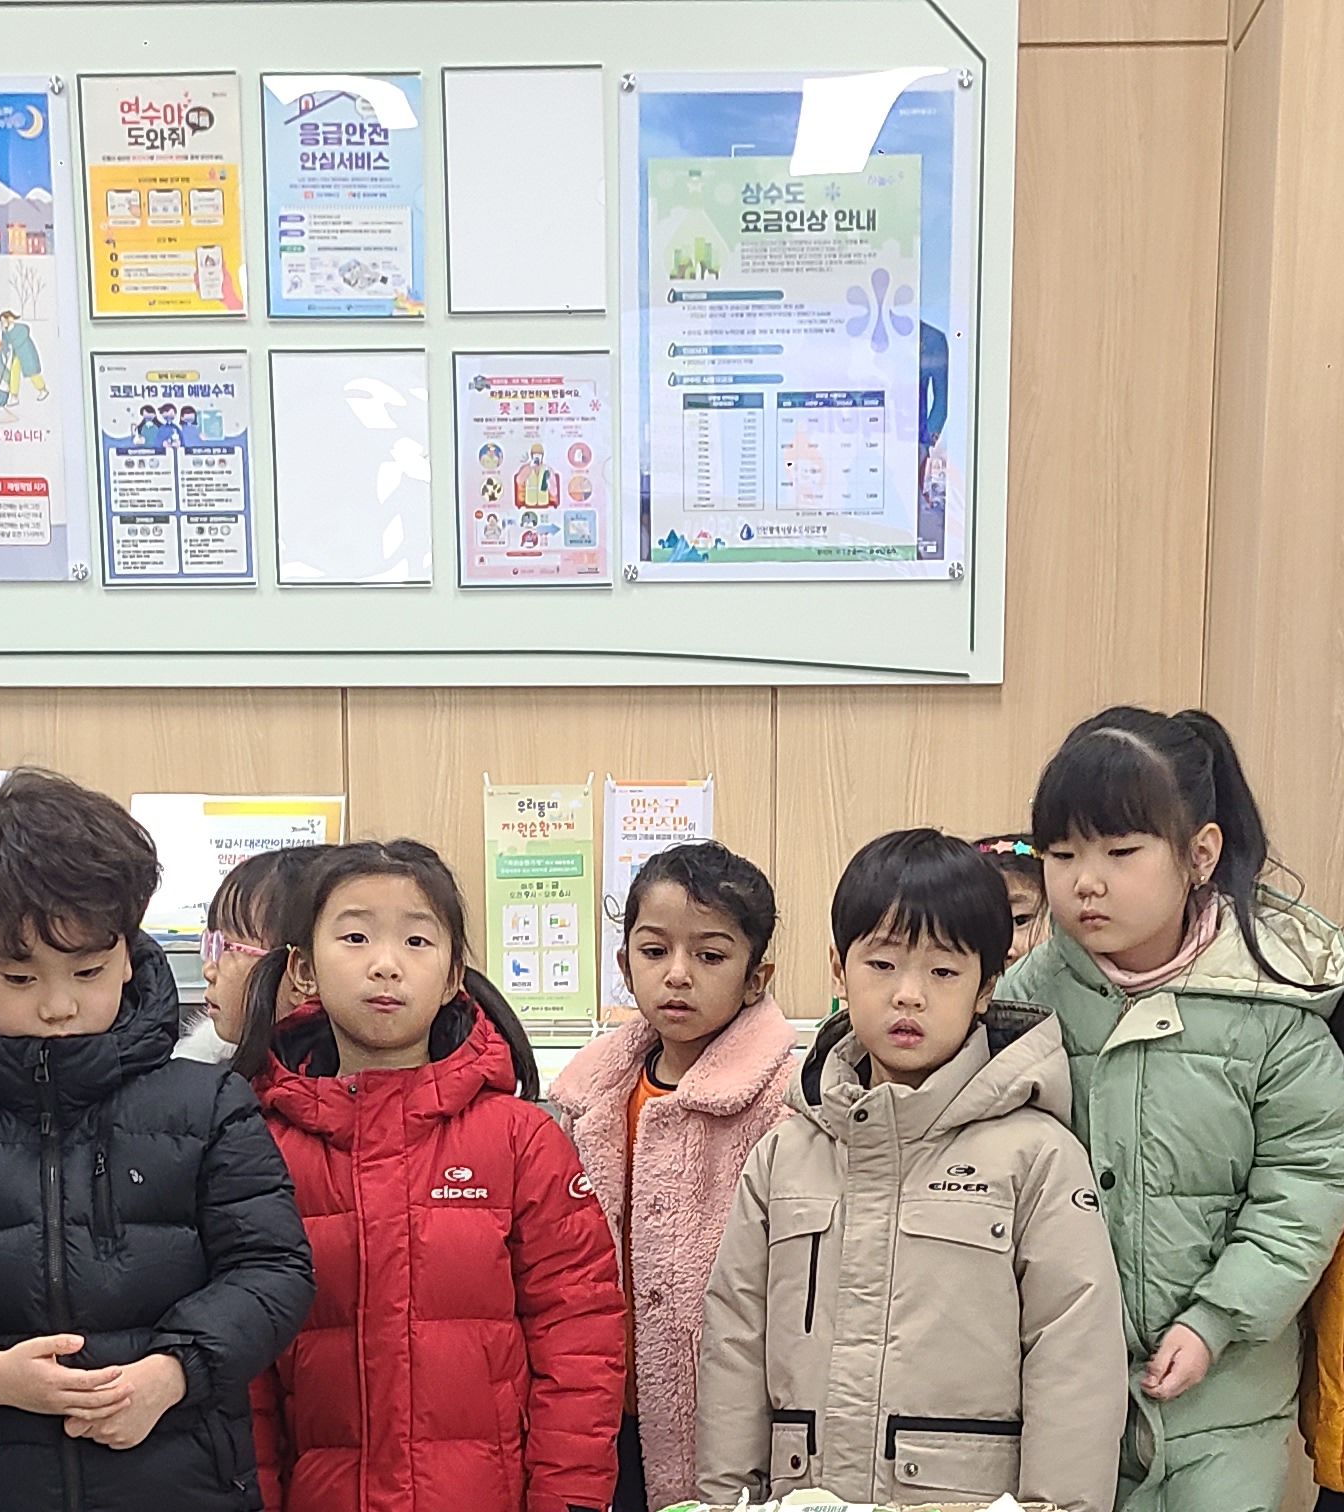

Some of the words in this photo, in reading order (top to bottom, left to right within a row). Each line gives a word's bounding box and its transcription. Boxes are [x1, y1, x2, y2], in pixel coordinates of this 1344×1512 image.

[120, 96, 184, 126] 연수야
[128, 127, 186, 151] 도와줘
[299, 122, 389, 146] 응급안전
[300, 152, 390, 171] 안심서비스
[741, 183, 805, 205] 상수도
[741, 210, 827, 233] 요금인상
[835, 210, 876, 232] 안내
[110, 385, 158, 399] 코로나19
[162, 385, 184, 398] 감염
[188, 384, 234, 398] 예방수칙
[518, 798, 558, 817] 우리동네
[631, 798, 679, 813] 연수구
[502, 821, 574, 838] 자원순환가게
[431, 1184, 488, 1199] EIDER
[929, 1180, 989, 1193] EIDER
